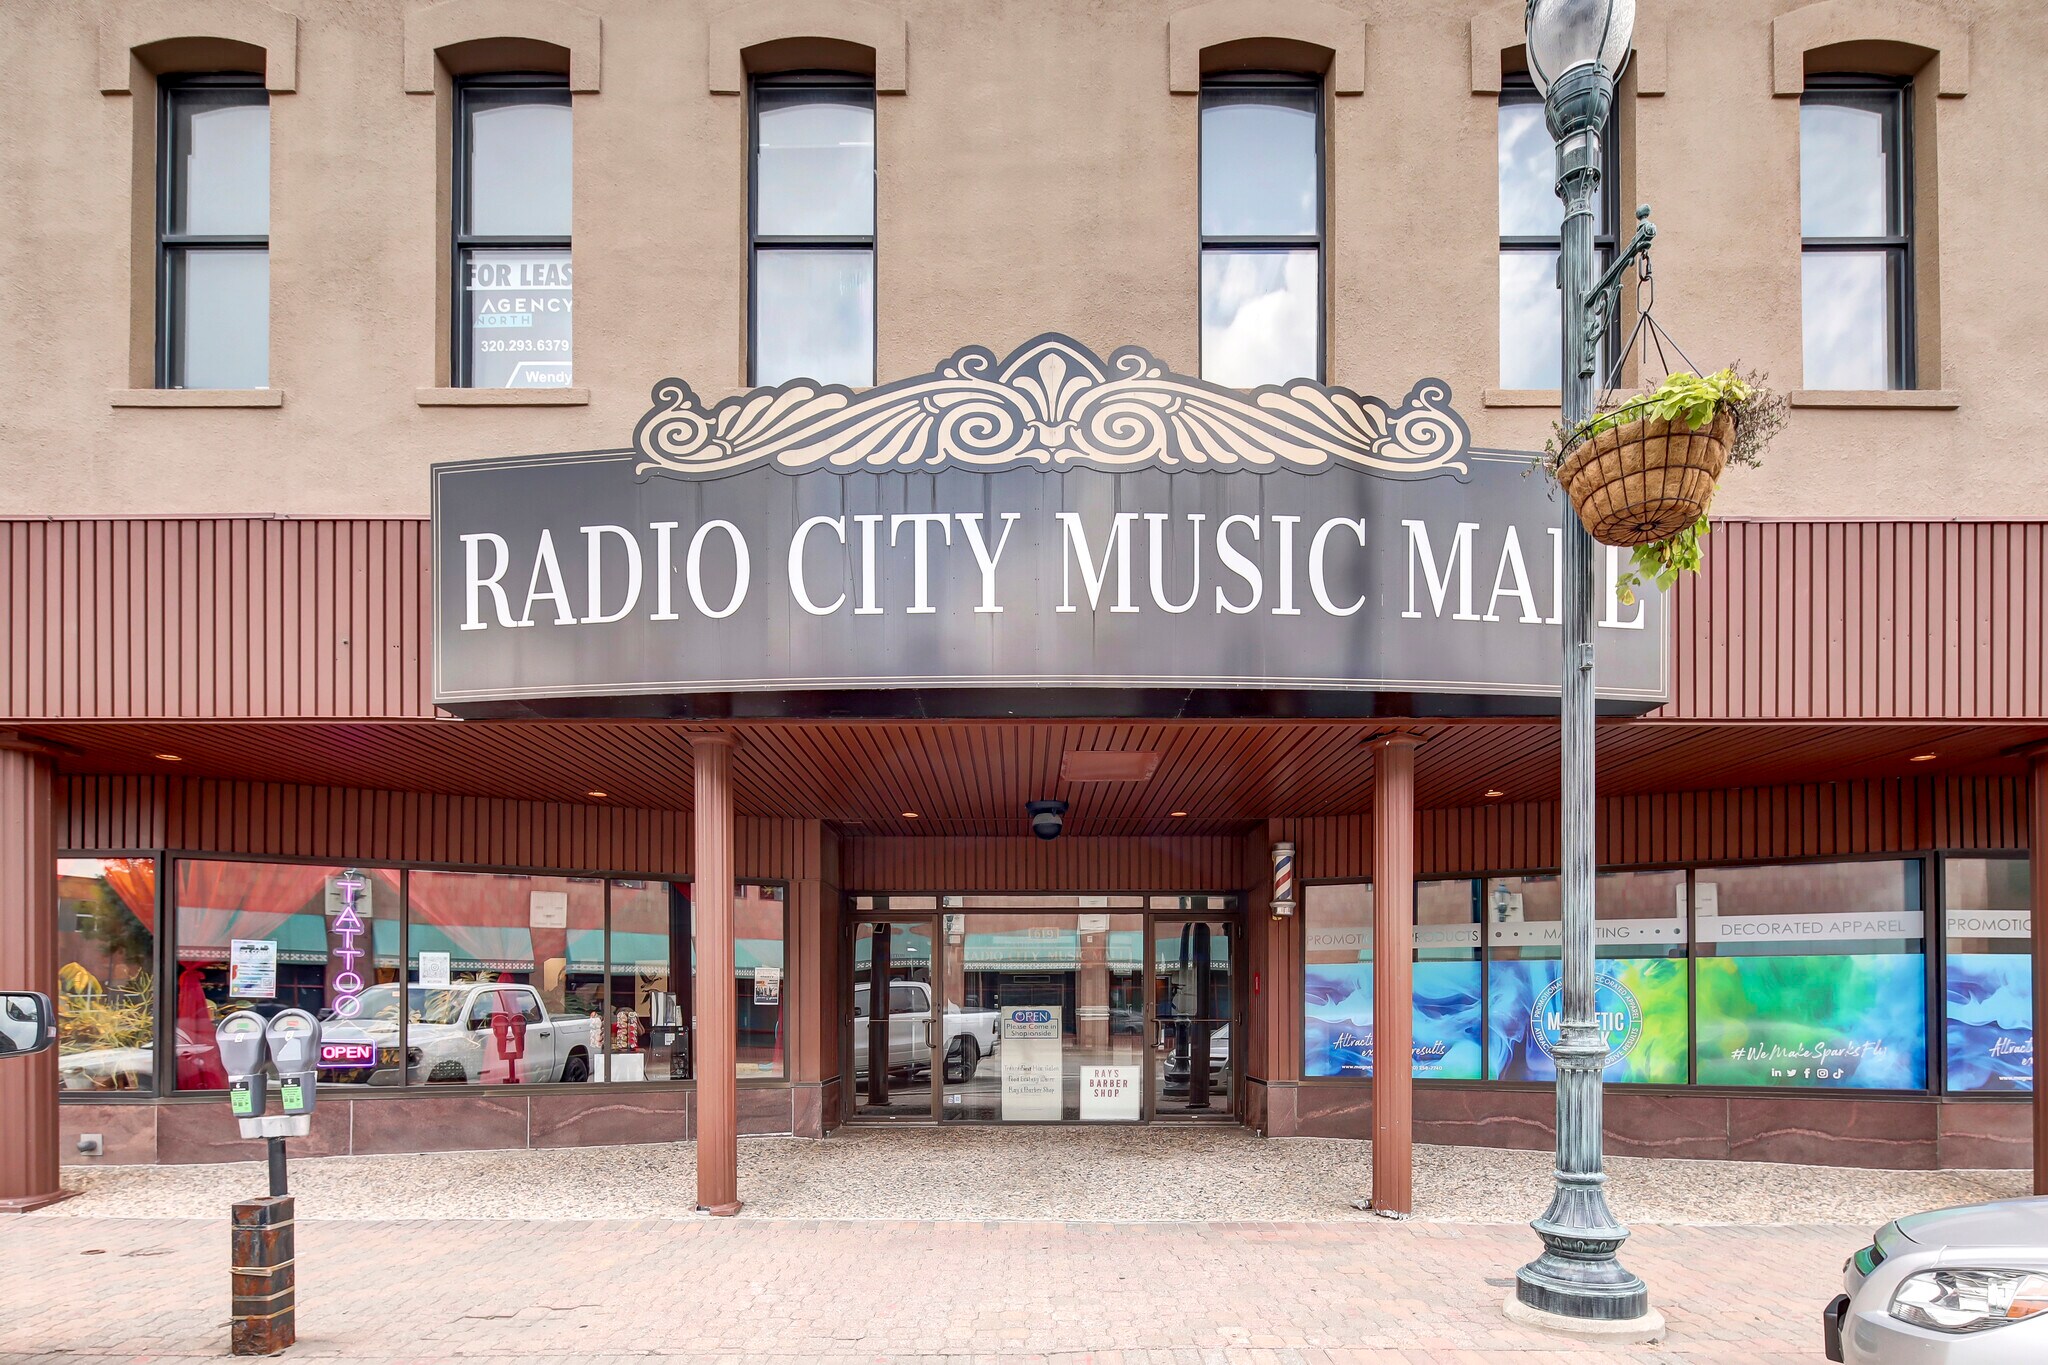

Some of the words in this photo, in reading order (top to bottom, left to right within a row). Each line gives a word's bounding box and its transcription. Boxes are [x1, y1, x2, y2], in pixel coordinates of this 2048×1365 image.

[467, 263, 511, 287] FOR
[481, 298, 572, 313] AGENCY
[476, 315, 530, 325] NORTH
[481, 339, 570, 352] 320.293.6379
[525, 371, 572, 385] Wendy
[460, 520, 750, 630] RADIO
[787, 512, 1021, 616] CITY
[1055, 512, 1366, 617] MUSIC
[1544, 926, 1630, 939] MTING
[1721, 922, 1823, 936] DECORATED
[1829, 920, 1906, 934] APPAREL
[335, 881, 363, 1017] TATTOO
[1595, 975, 1627, 996] ECORATED
[1547, 1011, 1624, 1031] METIC
[322, 1046, 370, 1059] OPEN
[1089, 1079, 1128, 1088] BARBER
[1093, 1089, 1120, 1097] SHOP
